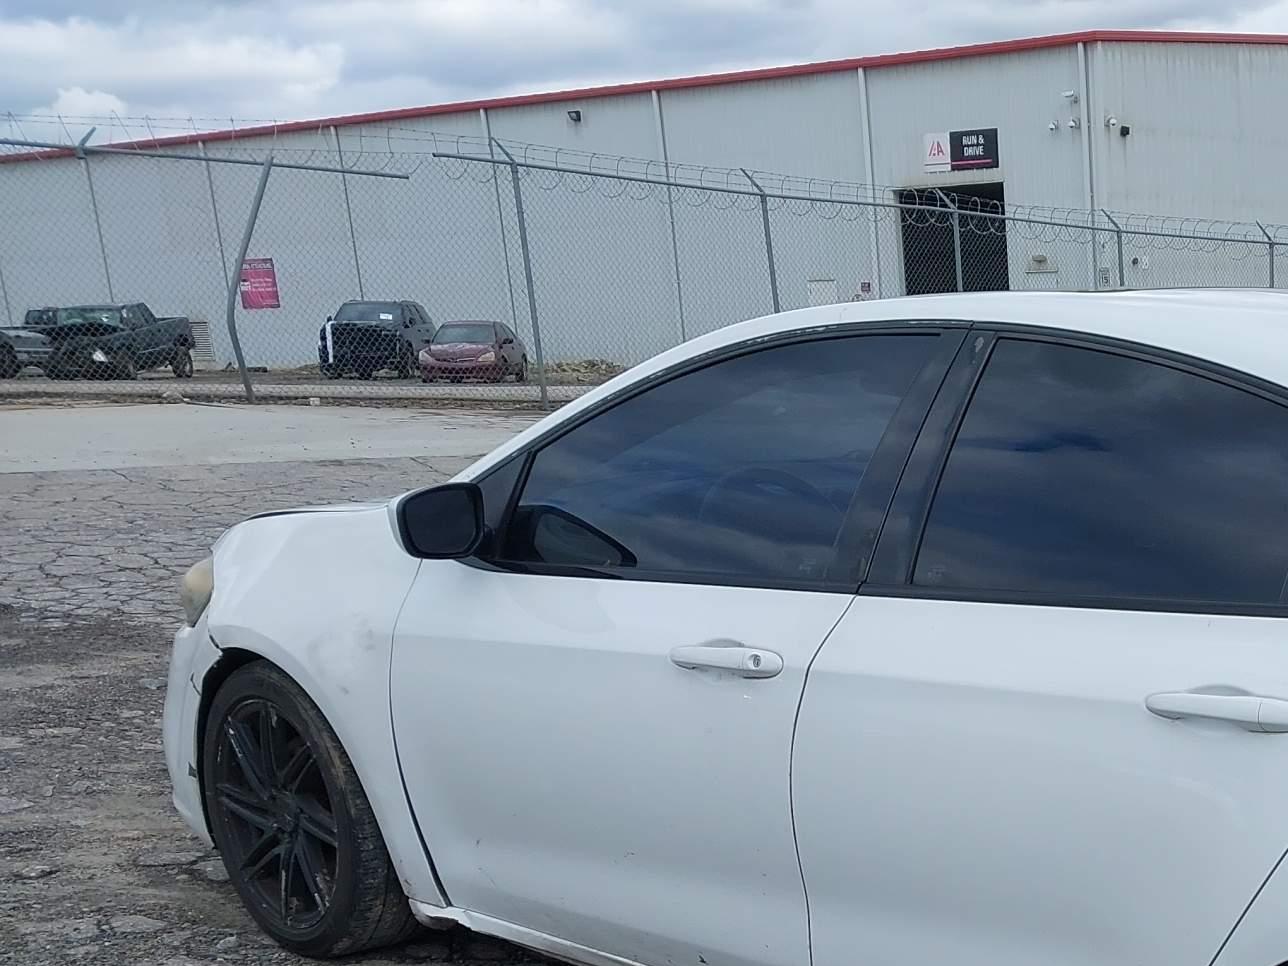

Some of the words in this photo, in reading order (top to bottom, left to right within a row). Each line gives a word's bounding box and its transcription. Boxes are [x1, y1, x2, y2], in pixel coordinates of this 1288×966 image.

[962, 135, 977, 145] RUN
[978, 134, 985, 144] &
[963, 146, 984, 156] DRIVE
